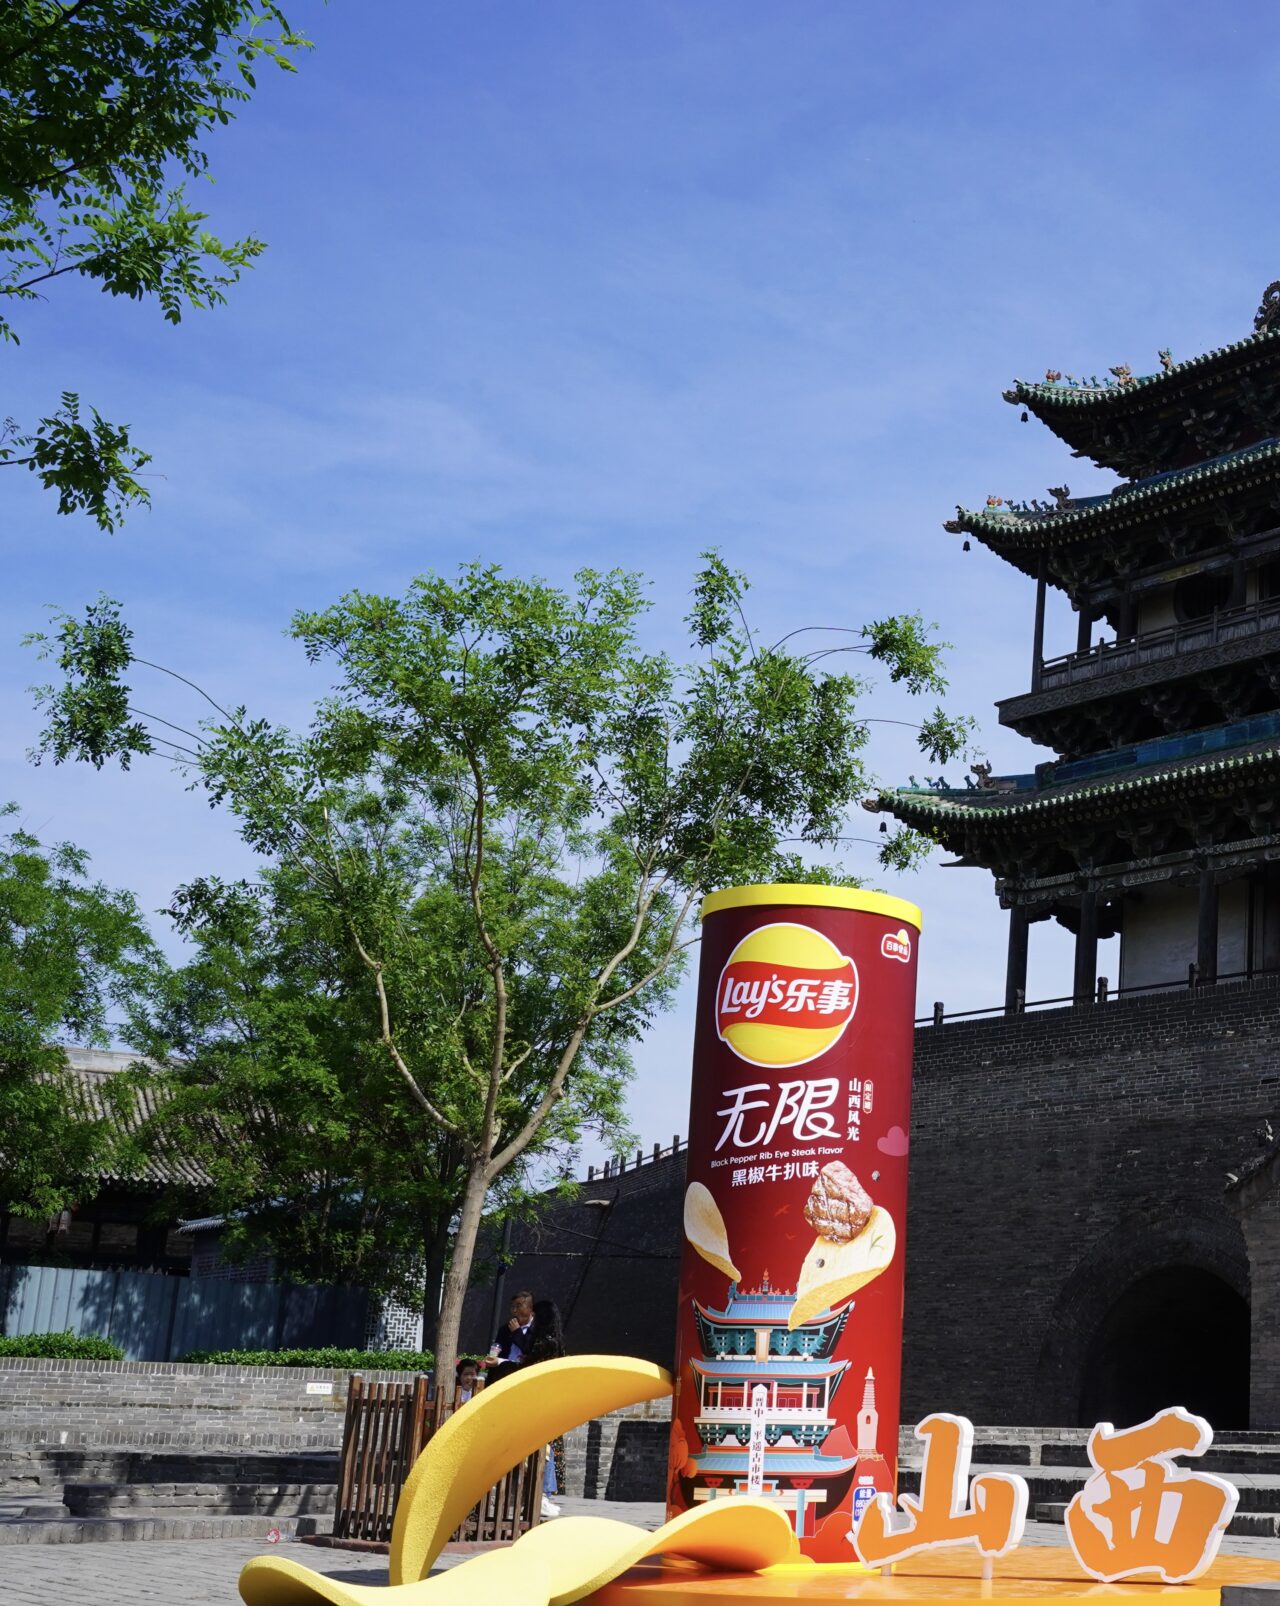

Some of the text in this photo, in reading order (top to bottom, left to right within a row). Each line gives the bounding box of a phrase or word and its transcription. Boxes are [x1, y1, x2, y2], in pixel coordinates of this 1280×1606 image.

[721, 974, 853, 1018] Lay's 乐事
[715, 1078, 841, 1152] 无限
[847, 1077, 861, 1142] 山西风光
[711, 1147, 844, 1168] Black Pepper Rib Eye Steak Flavor
[732, 1160, 820, 1187] 黑椒牛扒味
[851, 1407, 1240, 1584] 山西
